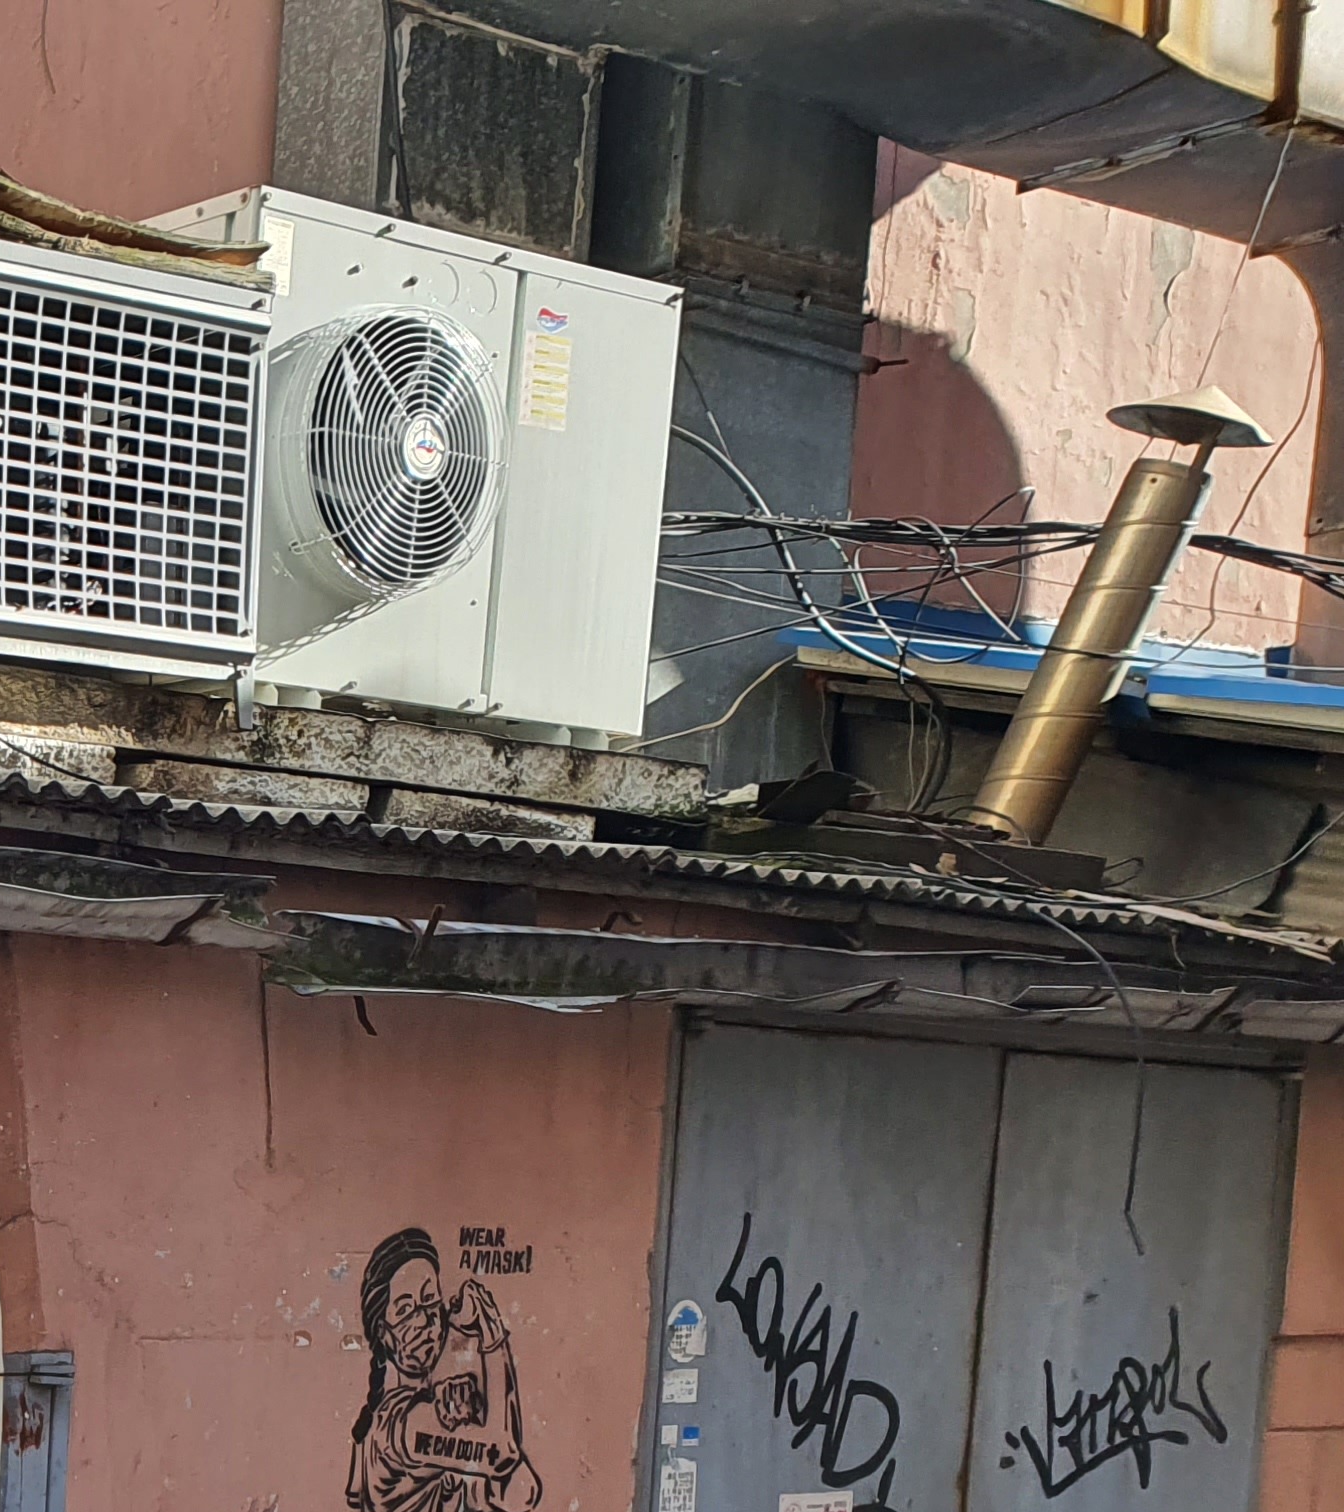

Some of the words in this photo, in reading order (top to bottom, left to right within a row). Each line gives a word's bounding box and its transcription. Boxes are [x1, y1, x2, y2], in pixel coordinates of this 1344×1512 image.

[459, 1226, 506, 1248] WEAR
[459, 1249, 471, 1269] A
[472, 1245, 533, 1275] MASK!
